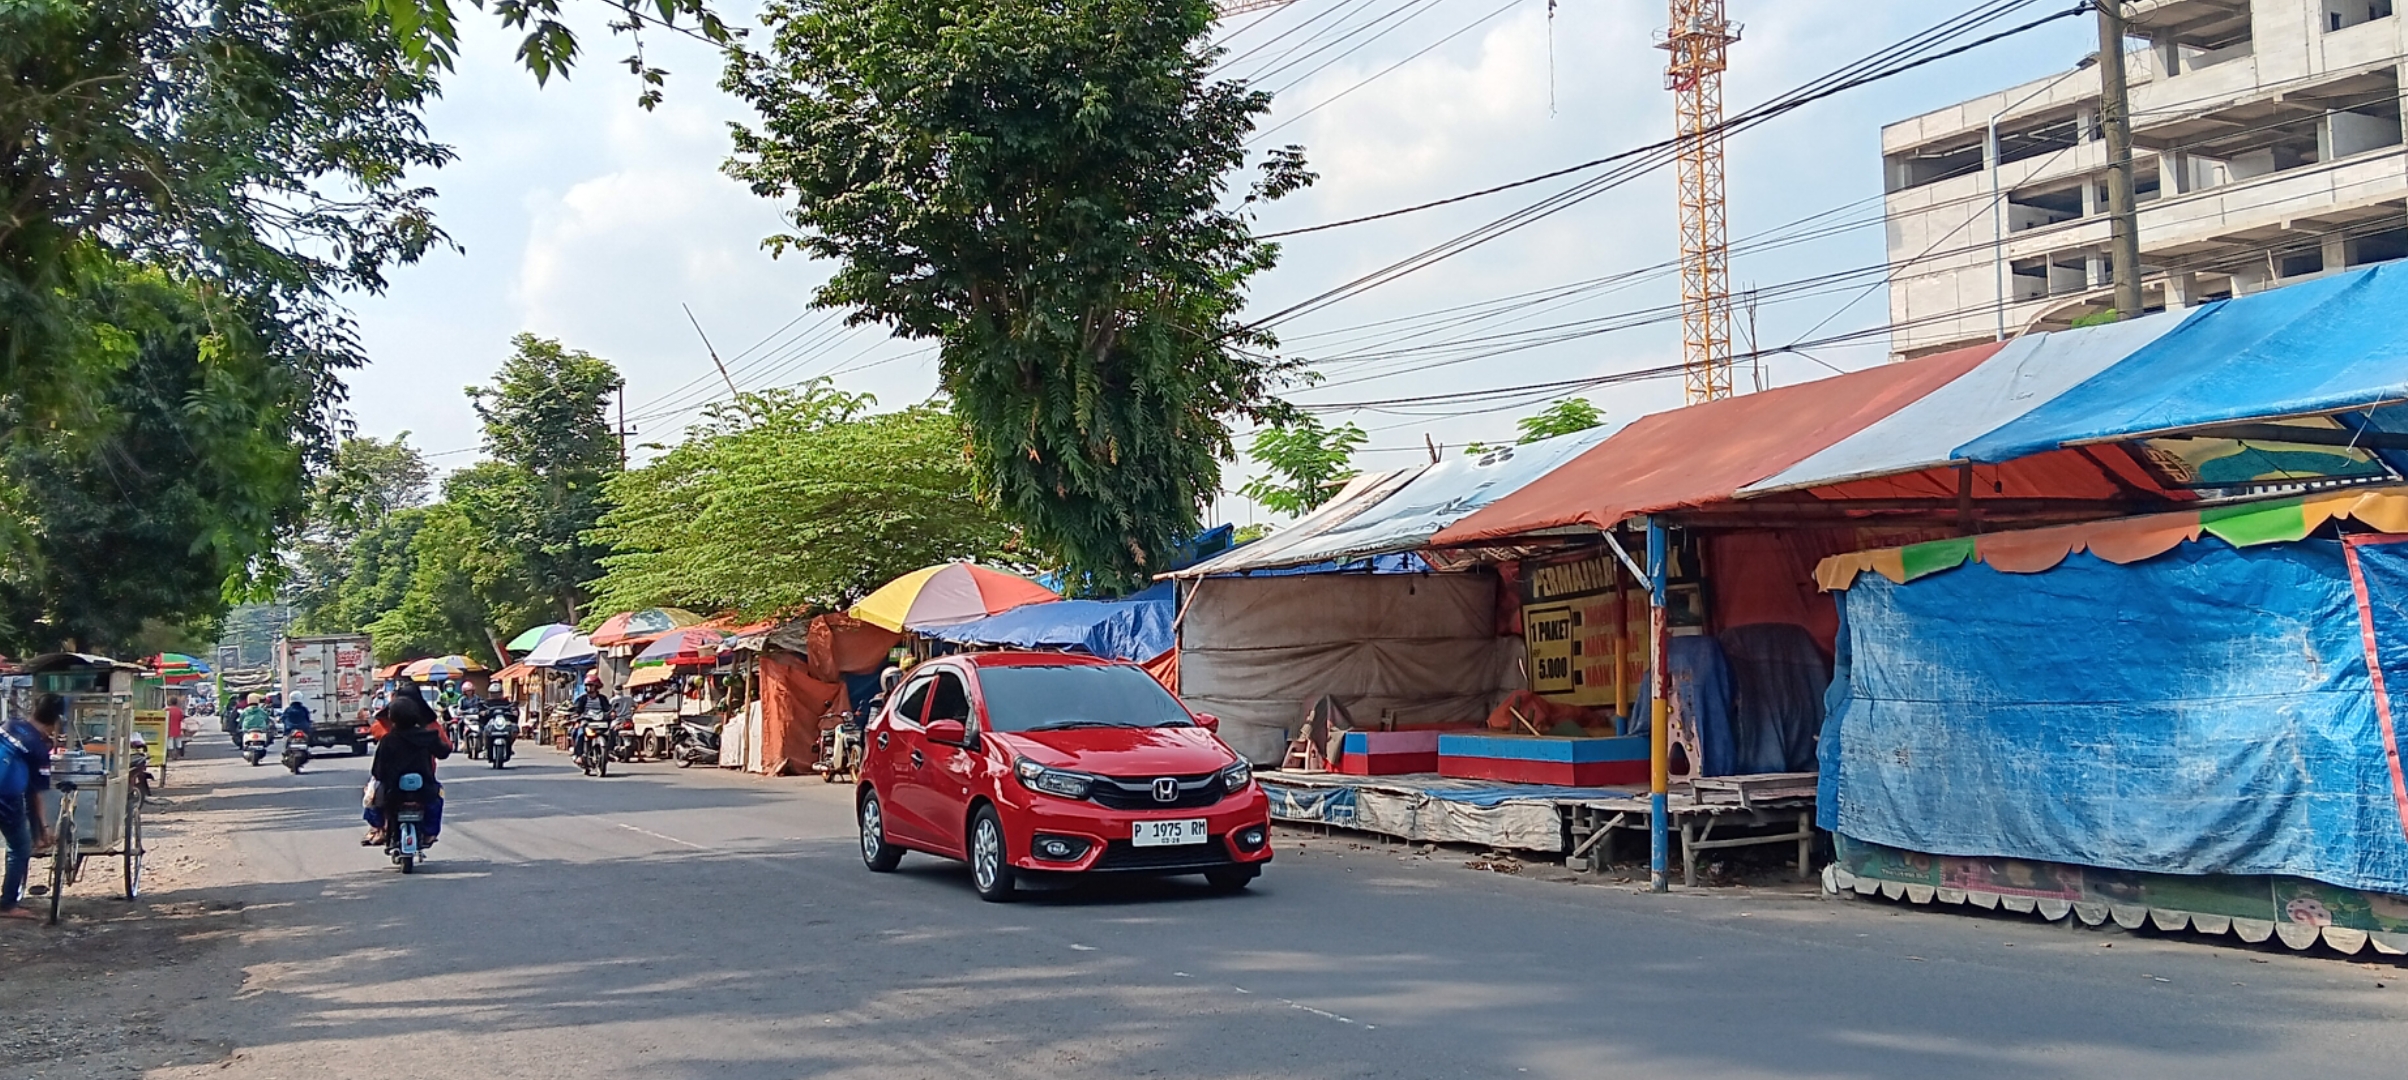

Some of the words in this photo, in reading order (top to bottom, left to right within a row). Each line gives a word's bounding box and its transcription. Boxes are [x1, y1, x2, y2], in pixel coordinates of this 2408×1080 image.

[1533, 556, 1616, 598] PERMAINA
[1531, 622, 1537, 642] 1
[1538, 619, 1569, 642] PAKET
[1538, 656, 1567, 679] 5.000
[1135, 824, 1142, 838] P
[1153, 823, 1181, 837] 1975
